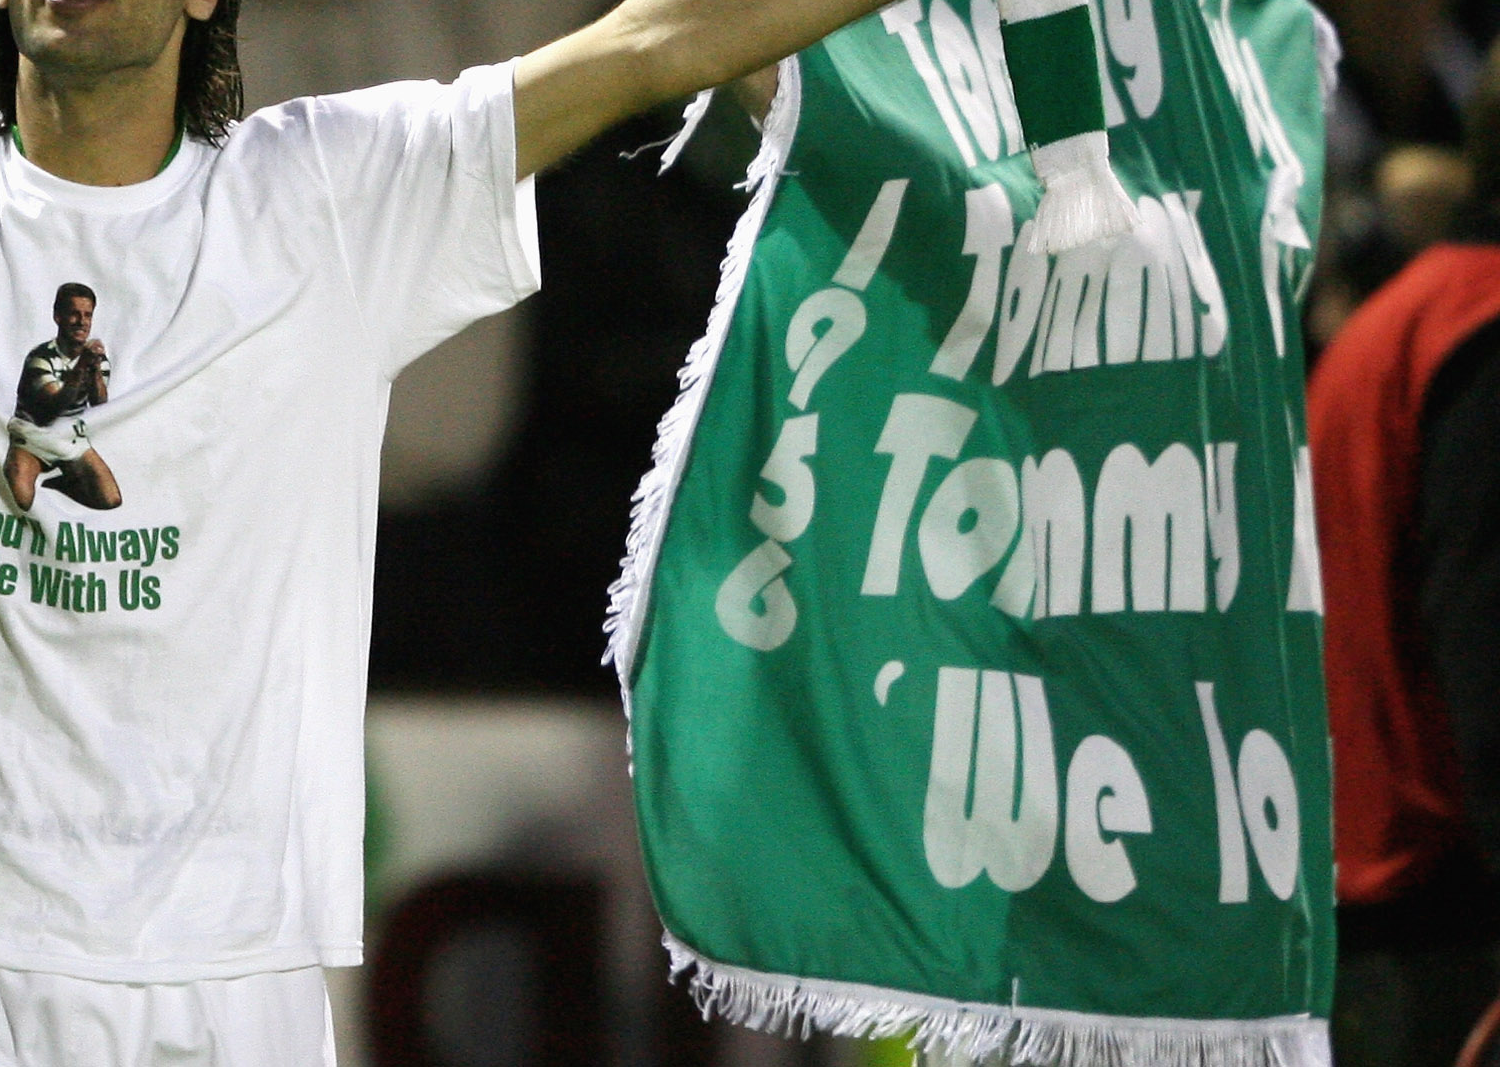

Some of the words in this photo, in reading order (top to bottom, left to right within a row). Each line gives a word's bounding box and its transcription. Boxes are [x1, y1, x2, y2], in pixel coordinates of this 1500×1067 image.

[929, 183, 1229, 386] Tommy
[55, 520, 180, 567] Always
[859, 393, 1241, 620] Tommy
[30, 562, 107, 613] With
[118, 569, 161, 611] Us
